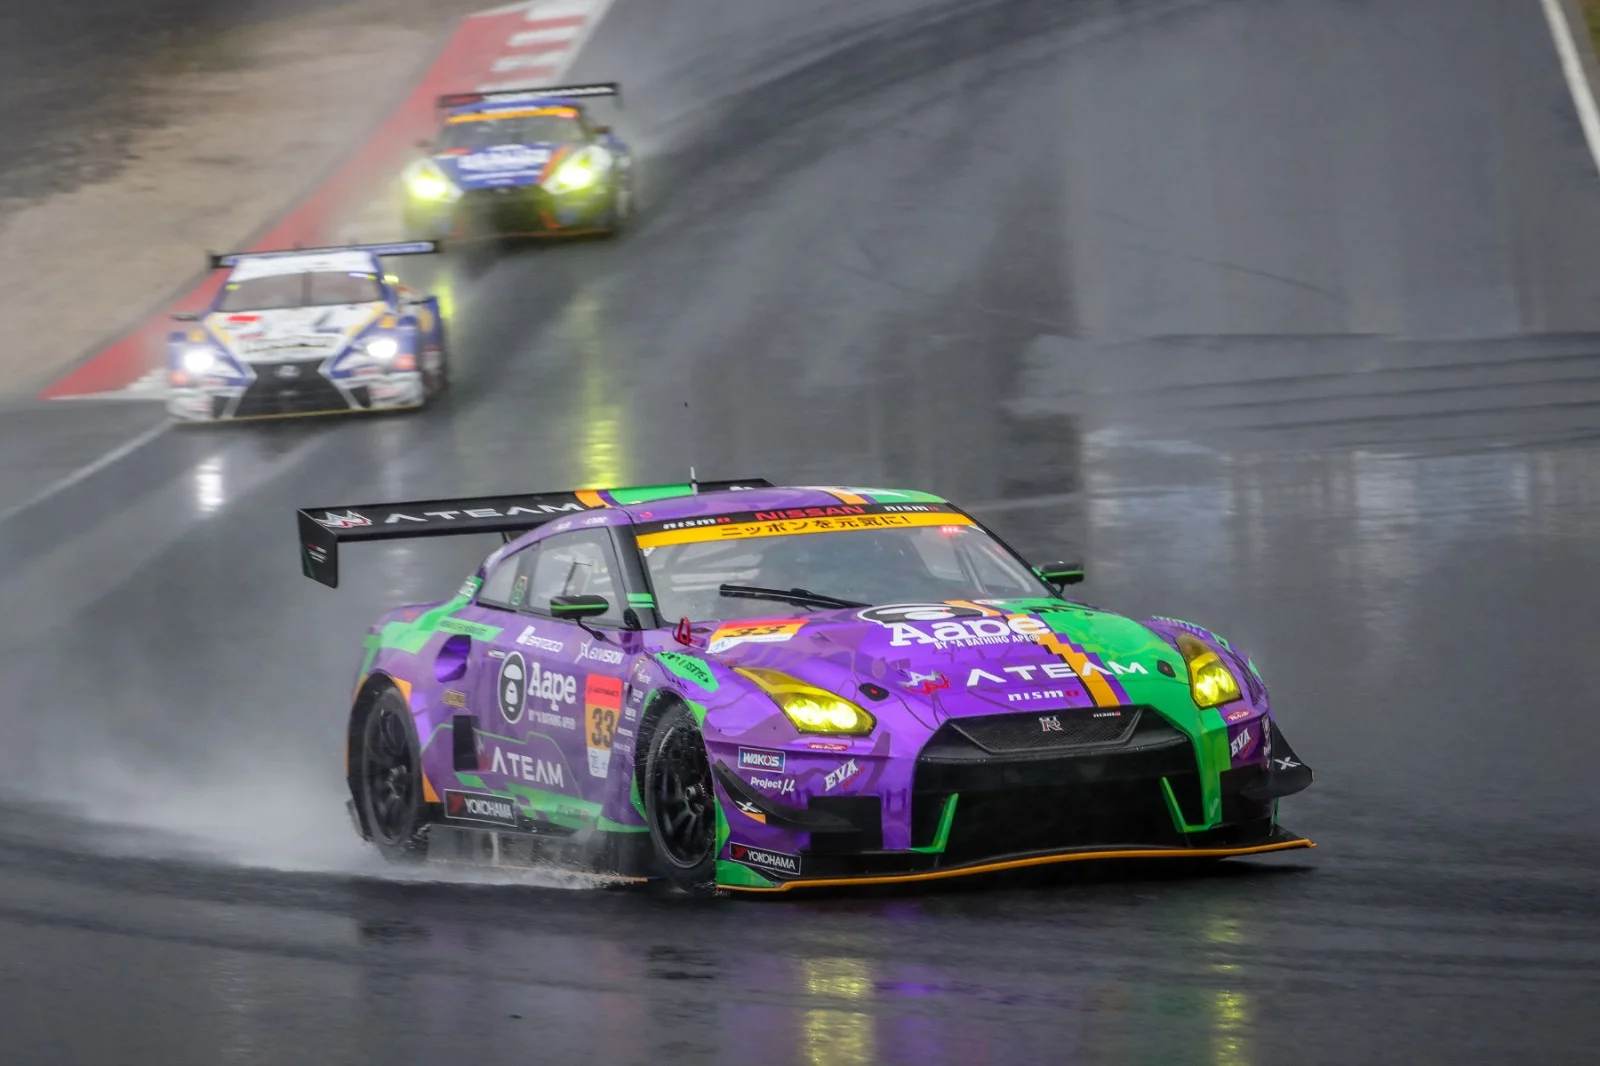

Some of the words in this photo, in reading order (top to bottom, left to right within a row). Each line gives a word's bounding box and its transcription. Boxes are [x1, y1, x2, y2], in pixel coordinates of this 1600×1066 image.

[754, 506, 866, 521] NISSAN
[884, 505, 939, 513] nismo
[663, 517, 731, 530] nismo
[889, 617, 1051, 647] Aape
[934, 641, 948, 650] BY
[966, 635, 1010, 647] BATHING
[527, 662, 577, 712] Aape
[1008, 690, 1080, 701] nismo
[591, 707, 615, 749] 33
[1230, 728, 1251, 758] EVA
[750, 776, 782, 789] Project
[824, 758, 859, 792] EVA
[464, 798, 514, 820] YOKOHAMA
[747, 850, 796, 870] YOKOHAMA
